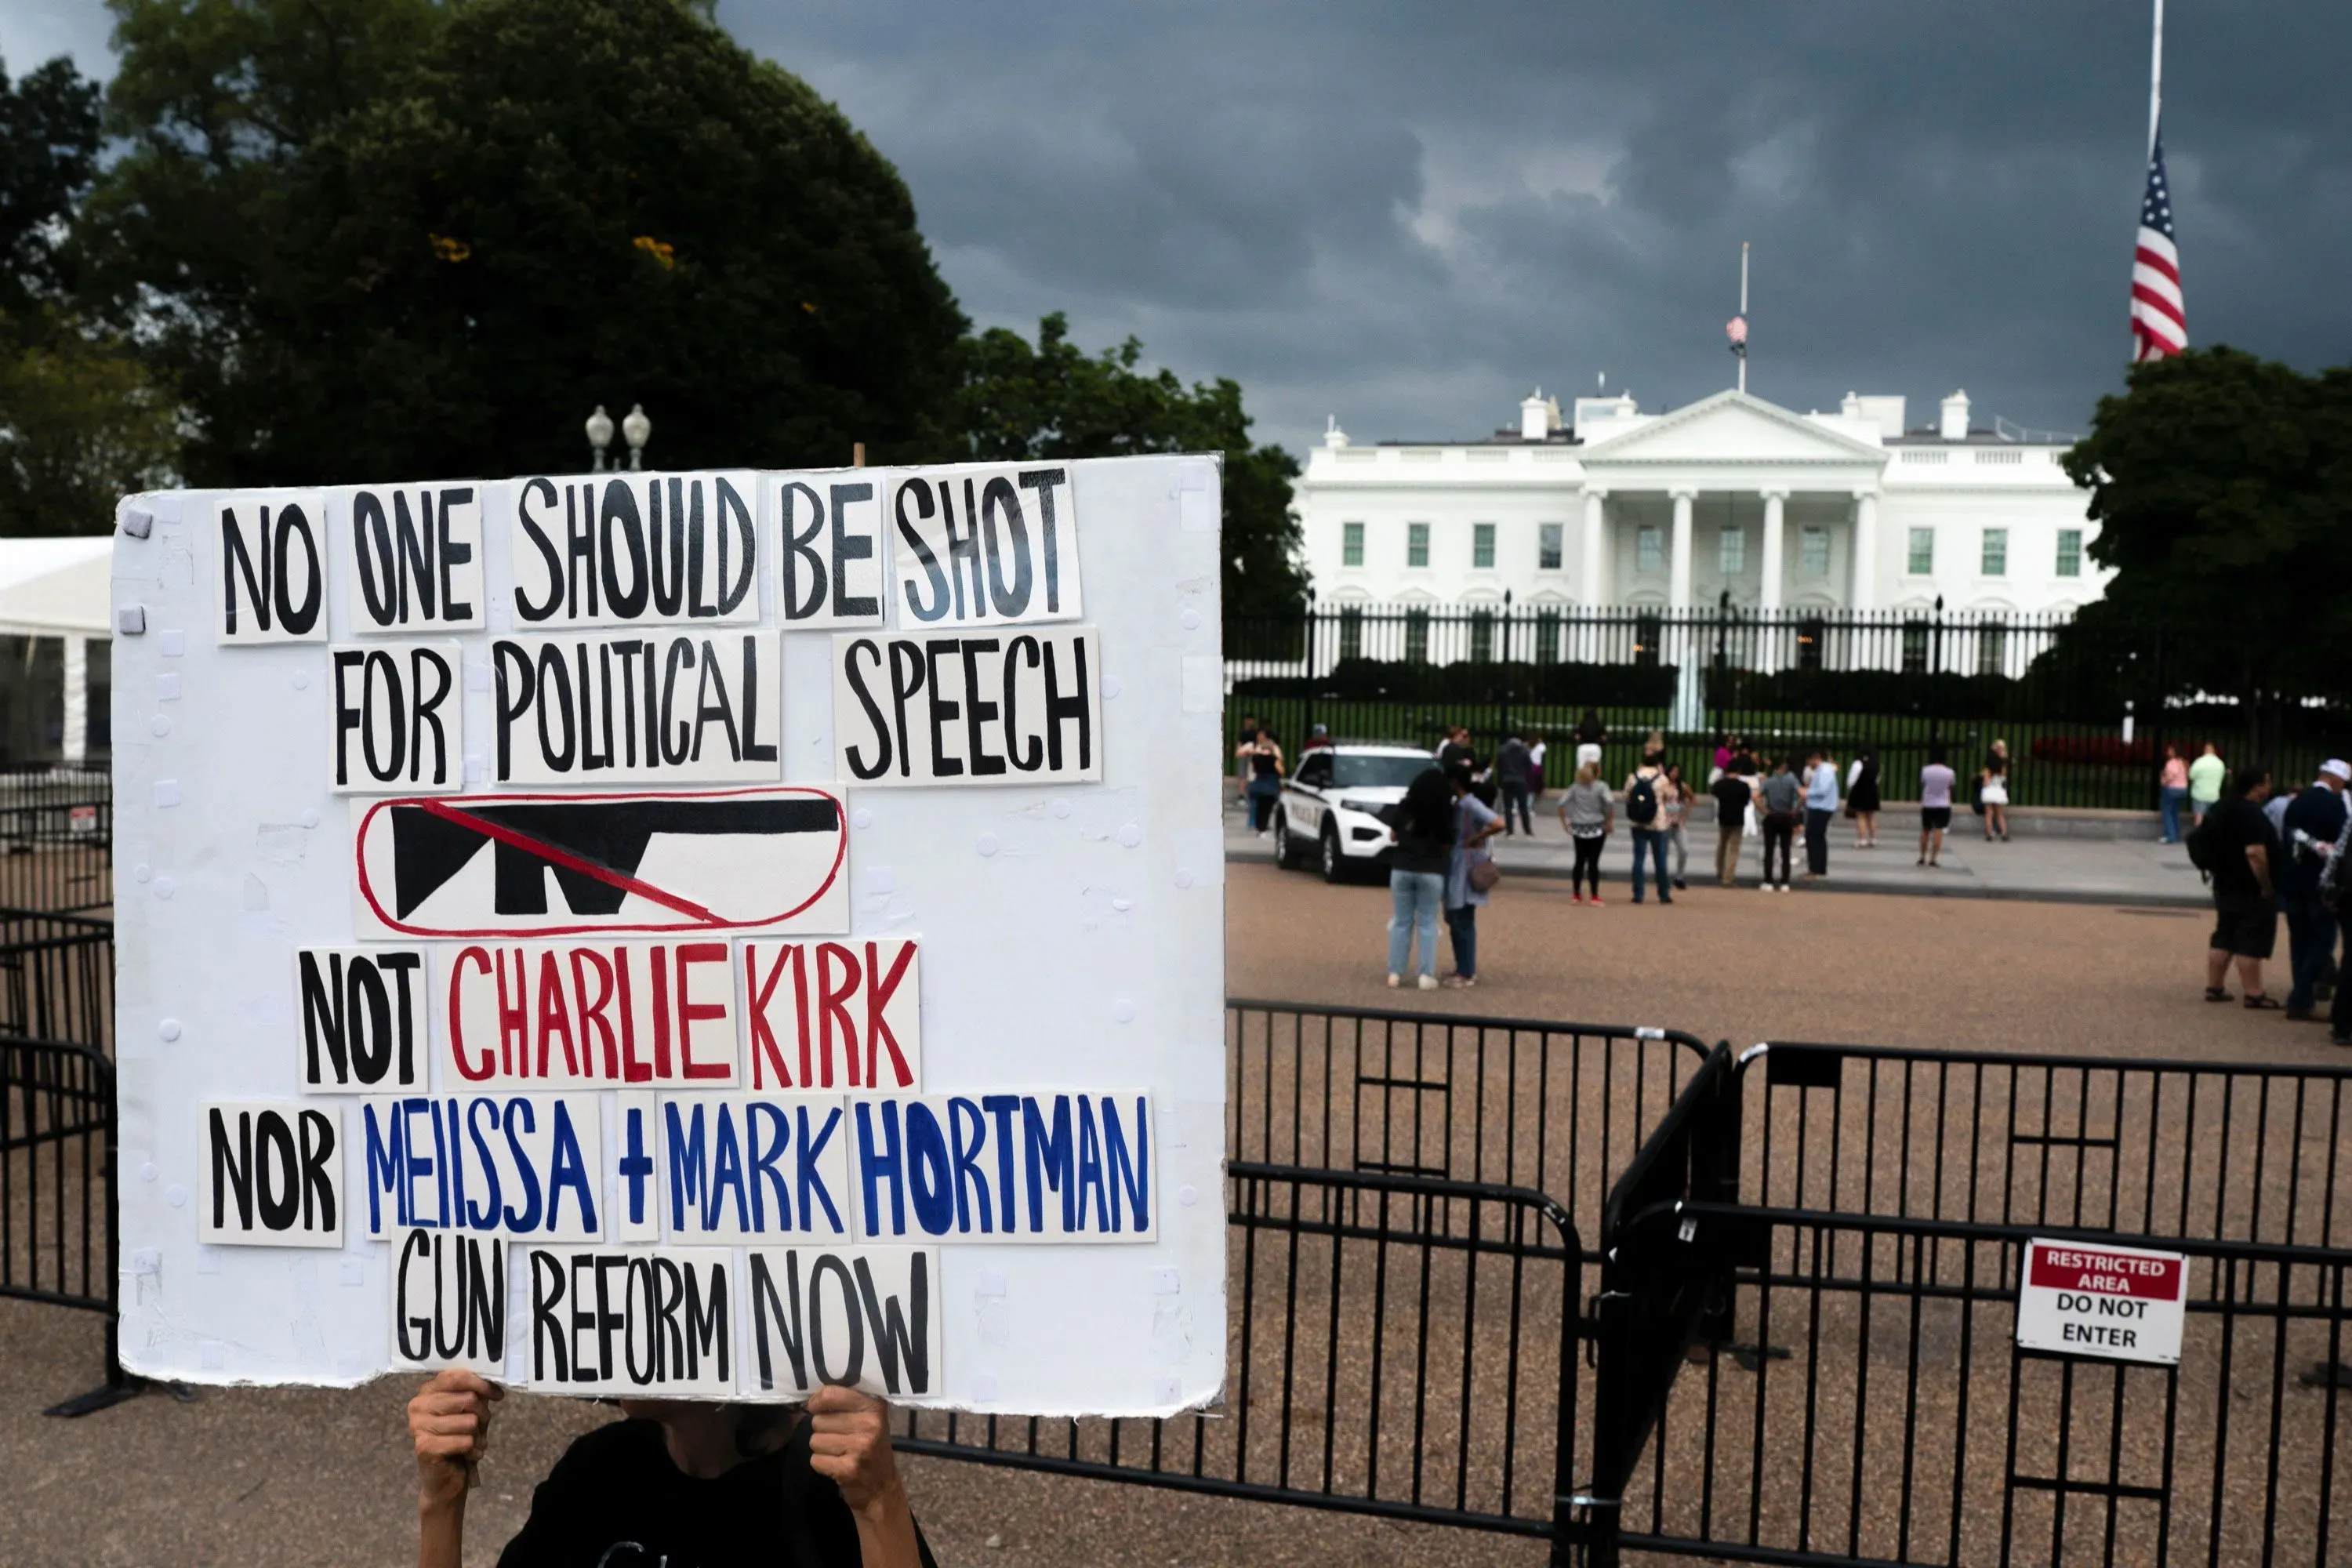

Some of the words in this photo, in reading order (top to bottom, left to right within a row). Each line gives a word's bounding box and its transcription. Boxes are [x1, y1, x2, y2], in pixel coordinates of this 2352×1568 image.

[222, 504, 321, 634] NO
[354, 488, 473, 626] ONE
[515, 477, 755, 621] SHOULD
[782, 482, 879, 619] BE
[895, 468, 1065, 621] SHOT
[334, 648, 452, 785] FOR
[492, 636, 777, 781] POLITICAL
[845, 635, 1090, 779] SPEECH
[299, 951, 420, 1084] NOT
[449, 944, 731, 1083] CHARLIE
[746, 941, 917, 1090] KIRK
[209, 1108, 336, 1232] NOR
[619, 1109, 653, 1224] +
[665, 1102, 844, 1233] MARK
[855, 1094, 1149, 1236] HORTMAN
[397, 1228, 504, 1363] GUN
[530, 1250, 728, 1385] REFORM
[750, 1250, 928, 1395] NOW
[2047, 1250, 2165, 1276] RESTRICTED
[2057, 1293, 2092, 1313] DO
[2099, 1298, 2148, 1319] NOT
[2078, 1274, 2130, 1293] AREA
[2063, 1323, 2136, 1348] ENTER
